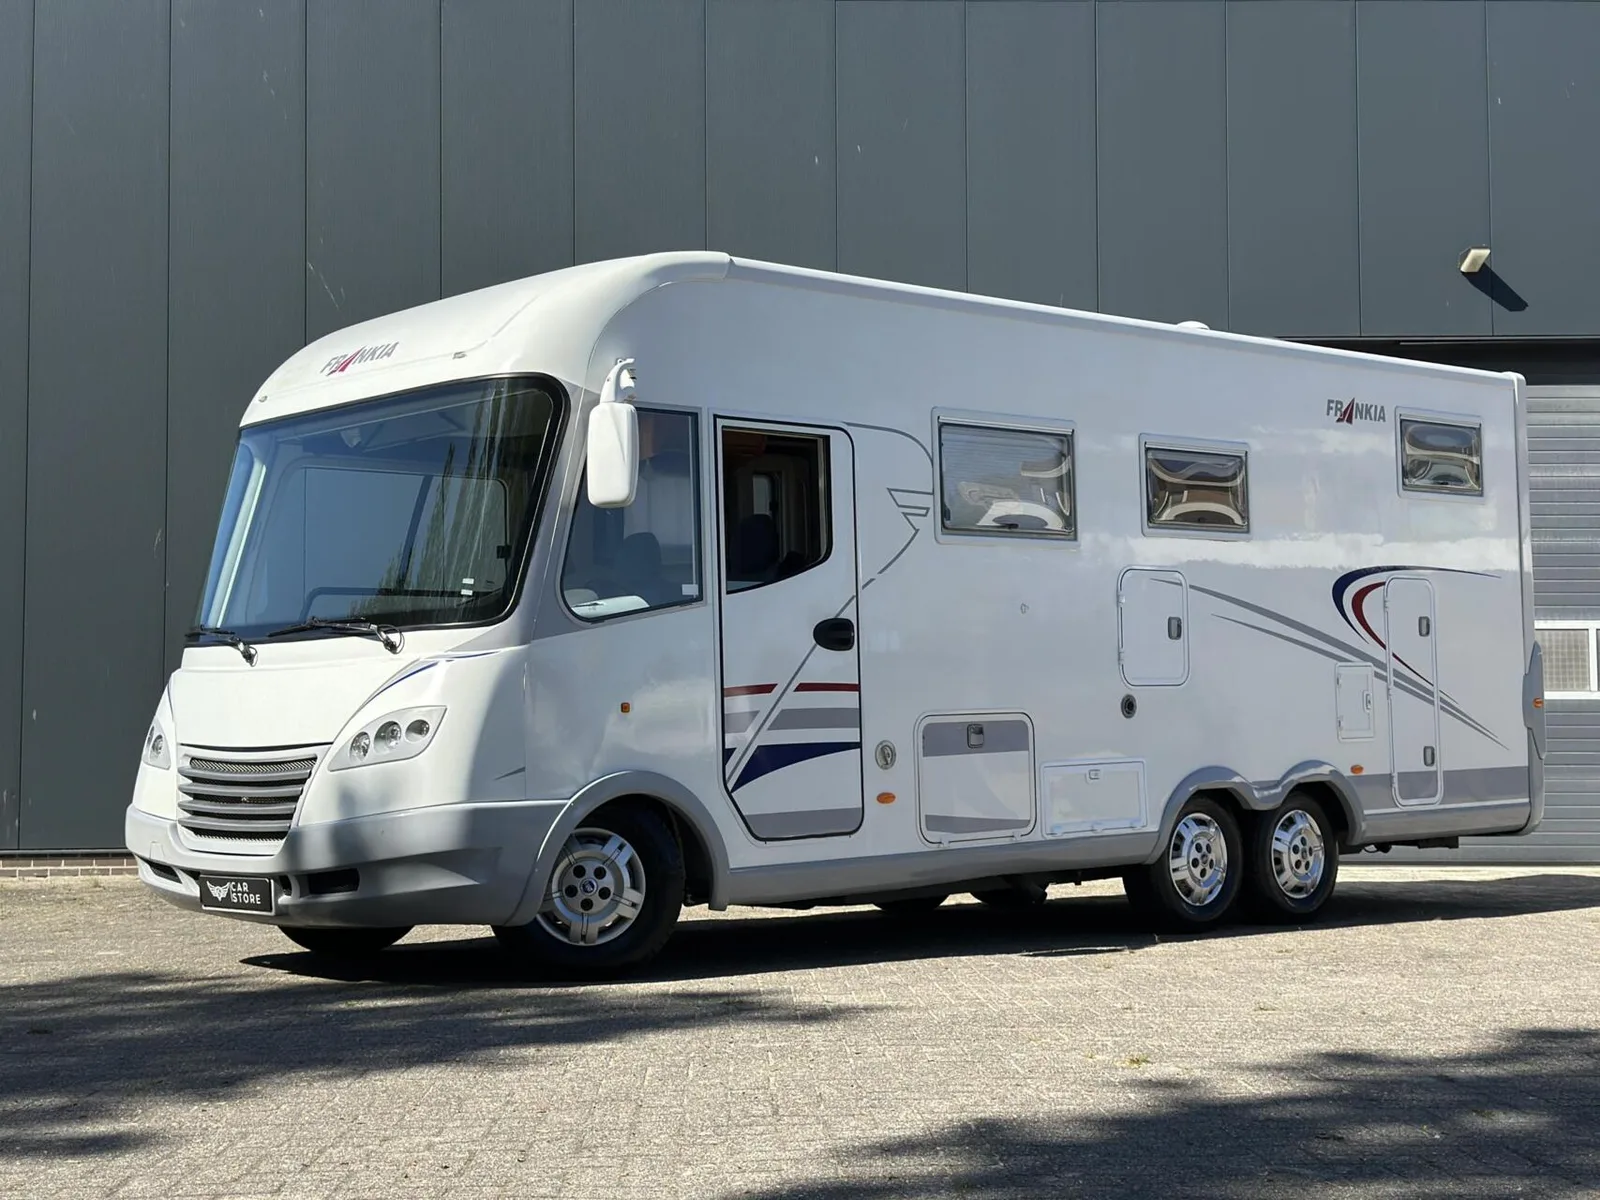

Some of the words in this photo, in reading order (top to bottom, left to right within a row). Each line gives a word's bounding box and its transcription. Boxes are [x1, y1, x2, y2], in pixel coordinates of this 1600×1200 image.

[320, 341, 399, 376] FRANKIA
[1326, 397, 1386, 425] FRANKIA
[231, 882, 249, 892] CAR
[232, 893, 261, 904] STORE
